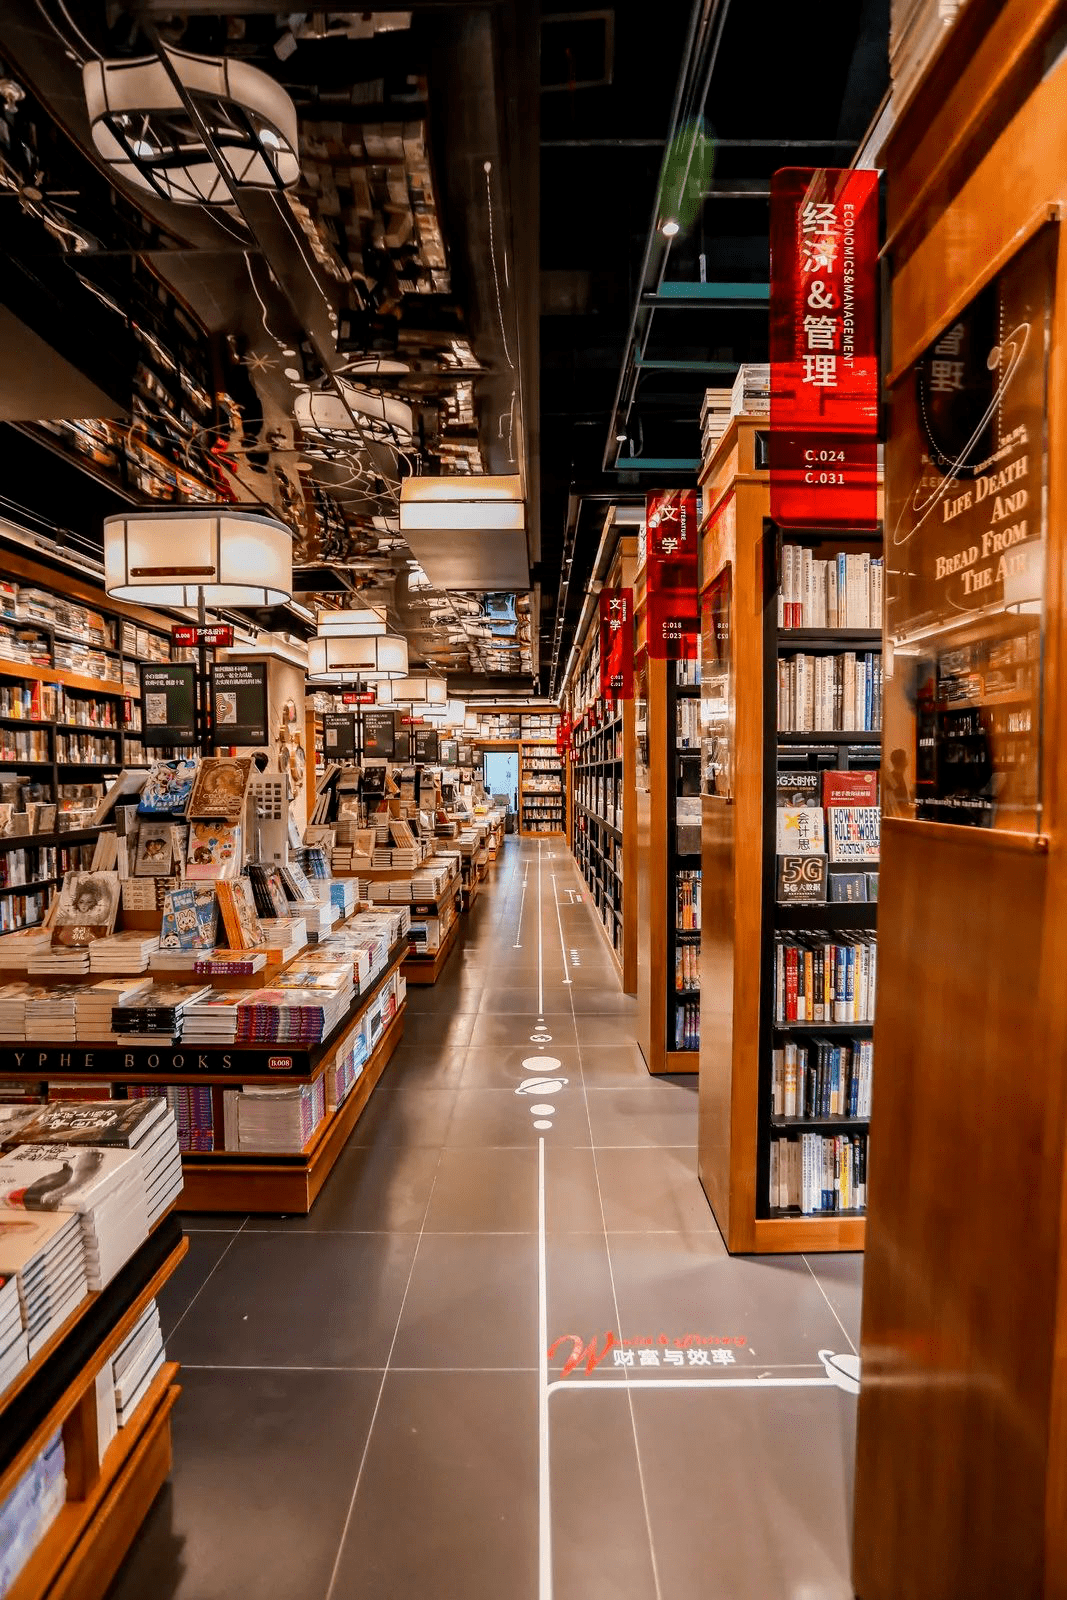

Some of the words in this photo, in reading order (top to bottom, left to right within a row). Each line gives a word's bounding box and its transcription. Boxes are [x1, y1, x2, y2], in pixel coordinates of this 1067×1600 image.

[802, 201, 838, 387] 经济&管理
[843, 203, 855, 369] ECONOMICS&MANAGEMENT
[804, 449, 846, 462] C.024
[804, 472, 846, 485] C.031
[943, 490, 973, 523] LIFE
[974, 455, 1029, 504] DEATH
[990, 489, 1029, 524] AND
[661, 505, 678, 554] 文学
[935, 546, 979, 581] BREAD
[981, 520, 1029, 559] FROM
[961, 567, 993, 595] THE
[609, 598, 622, 631] 文学
[859, 824, 880, 840] WORL
[782, 857, 823, 883] 5G
[783, 883, 821, 893] 5G大数据
[14, 1053, 95, 1068] YPHE
[124, 1054, 232, 1069] BOOKS
[271, 1058, 291, 1068] B.008
[612, 1348, 737, 1367] 财富与效率
